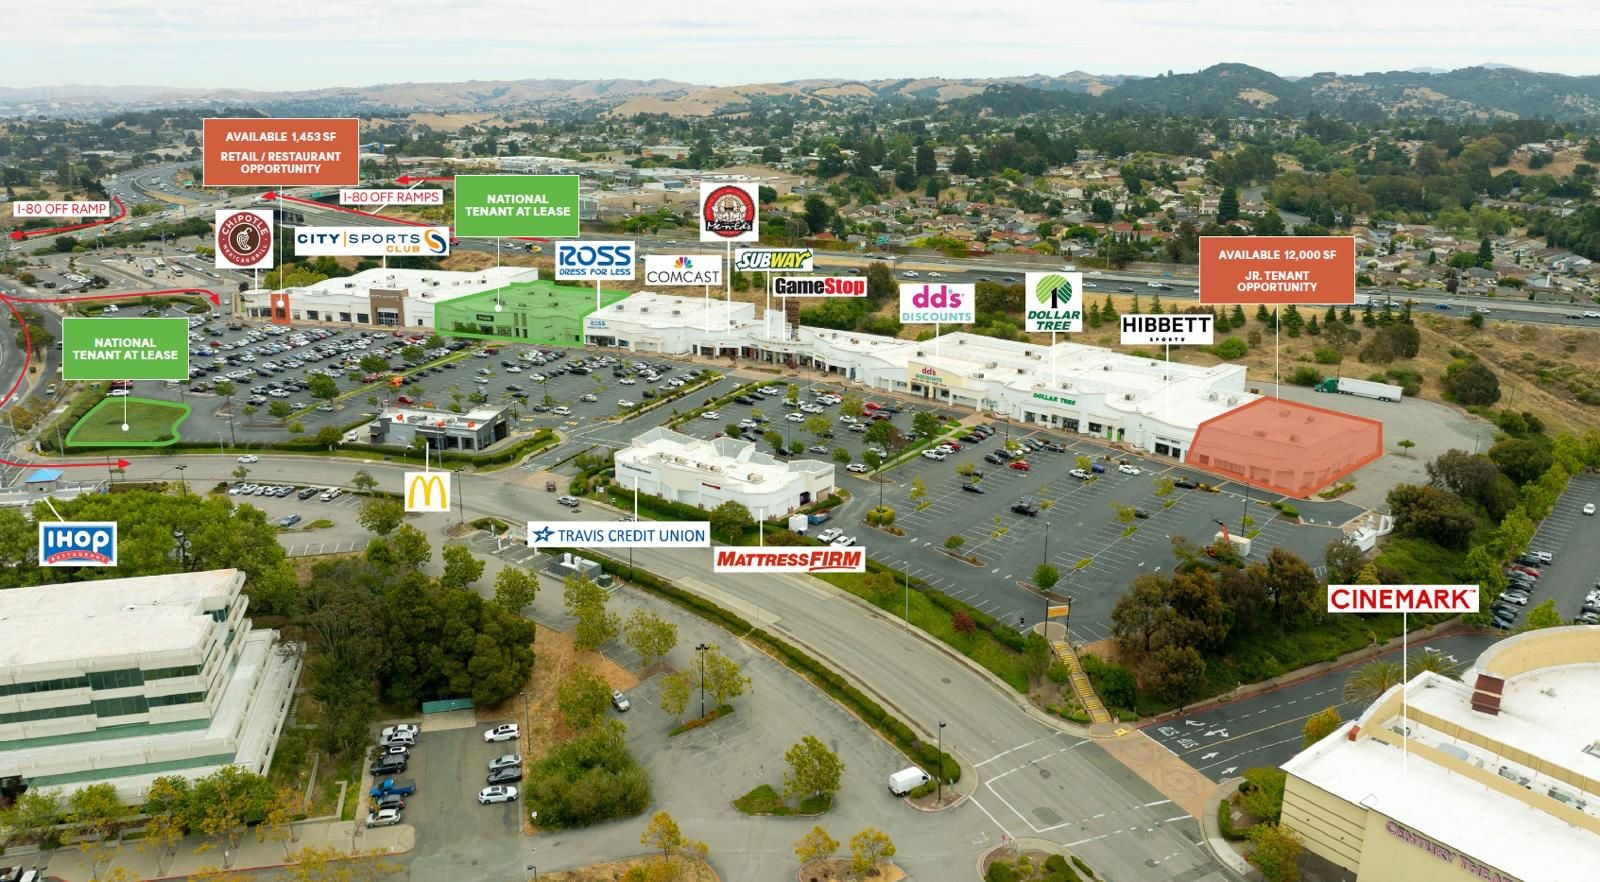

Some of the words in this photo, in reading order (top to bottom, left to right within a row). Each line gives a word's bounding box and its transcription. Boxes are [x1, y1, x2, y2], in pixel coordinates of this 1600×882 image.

[1032, 392, 1058, 402] DOLLAR
[1060, 397, 1077, 406] TREE
[1385, 820, 1457, 863] CENTURY
